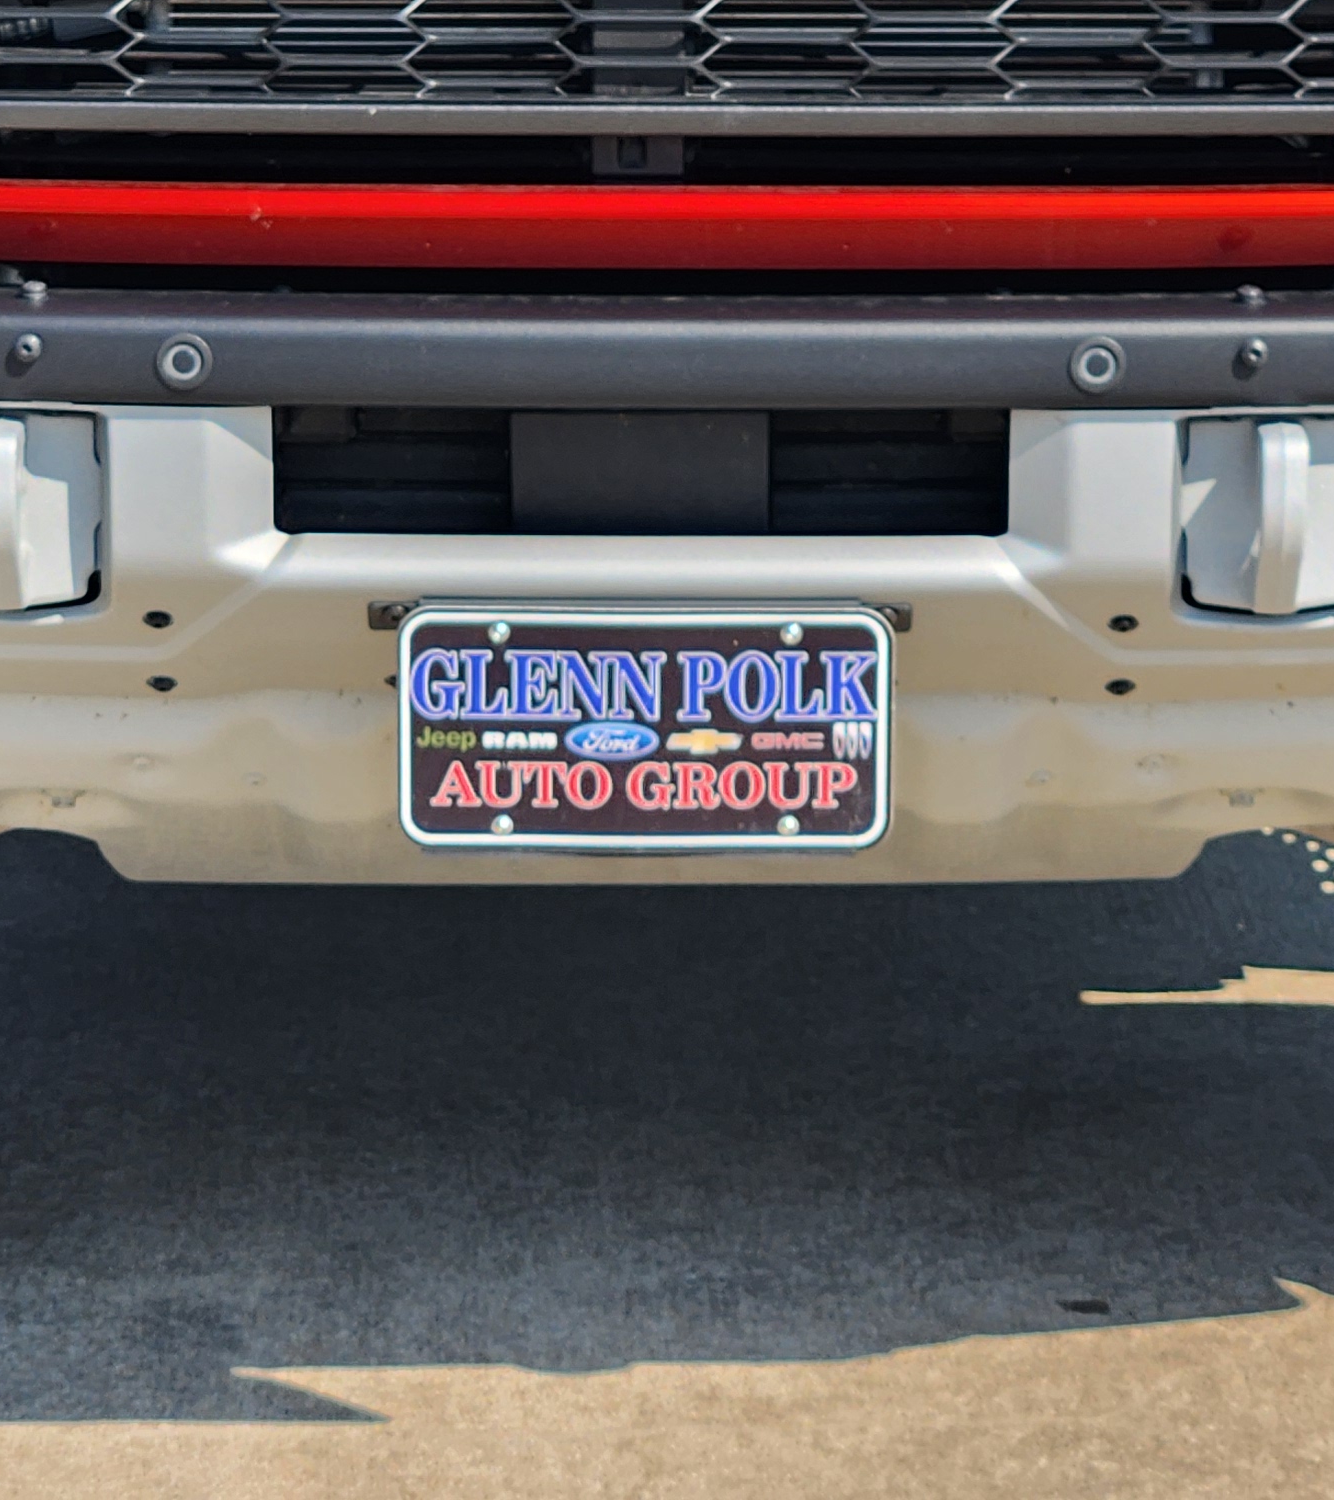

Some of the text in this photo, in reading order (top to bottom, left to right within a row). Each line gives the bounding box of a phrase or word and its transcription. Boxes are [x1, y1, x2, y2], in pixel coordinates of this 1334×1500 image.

[410, 647, 879, 723] GLENN POLK
[417, 725, 477, 753] Jeep
[481, 730, 559, 750] RAM
[751, 731, 825, 750] GMC
[430, 760, 858, 810] AUTO GROUP
